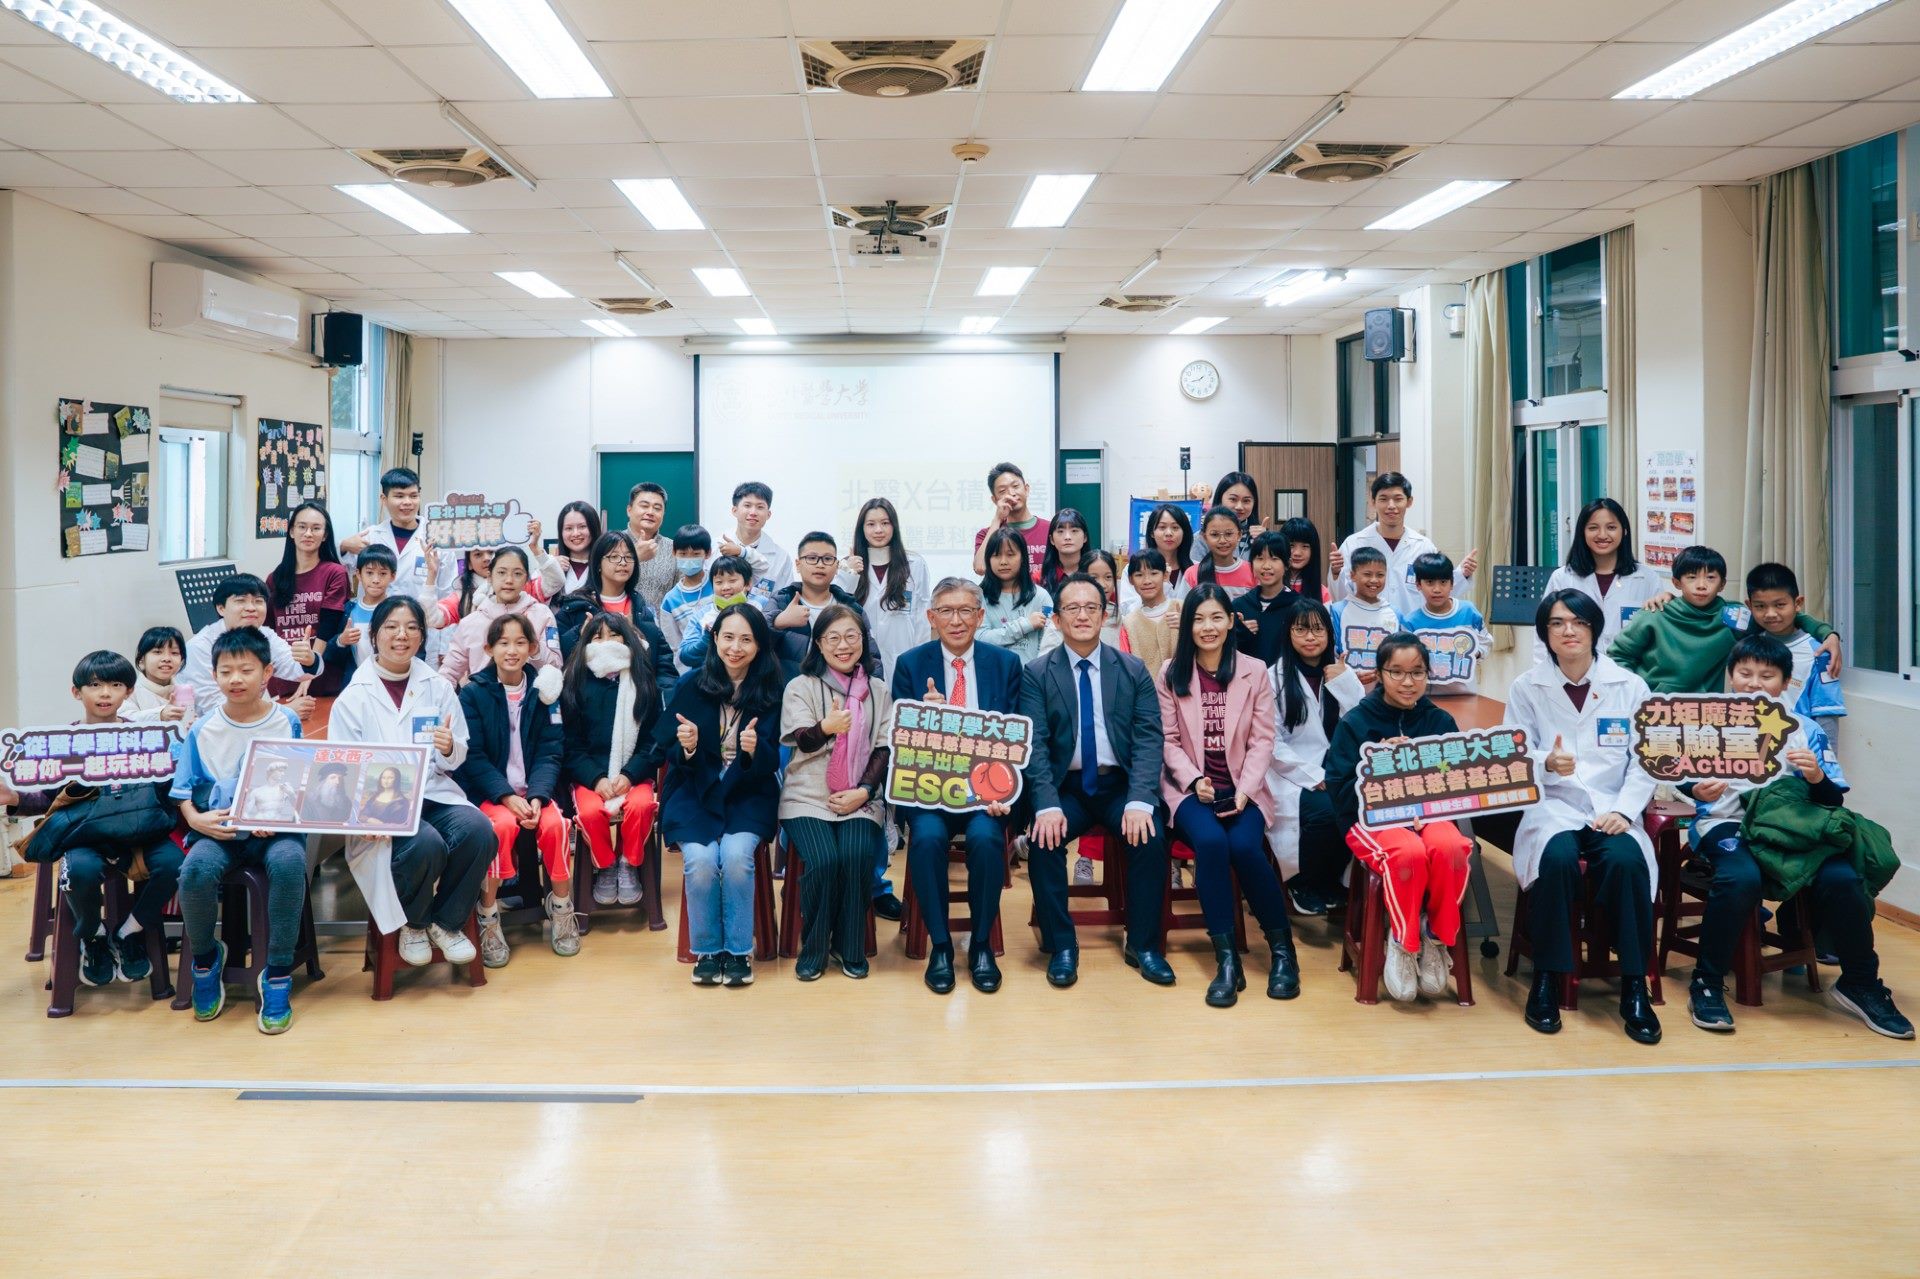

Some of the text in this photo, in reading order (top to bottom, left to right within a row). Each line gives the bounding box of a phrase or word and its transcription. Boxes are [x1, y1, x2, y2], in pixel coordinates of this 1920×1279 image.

[428, 503, 506, 520] 臺北醫學大學
[427, 518, 504, 546] 好棒棒
[276, 613, 319, 627] FUTURE
[285, 603, 307, 615] THE
[897, 706, 1026, 743] 臺北醫學大學
[1645, 701, 1756, 726] 力矩魔法
[24, 729, 165, 759] 從醫學到科學
[894, 728, 1025, 762] 台積電慈善基金會
[1370, 733, 1517, 776] 臺北醫學大學
[1644, 724, 1760, 760] 實驗室
[14, 751, 173, 782] 帶你一起玩科學
[896, 746, 972, 774] 聯手出擊
[1676, 755, 1766, 776] Action
[892, 768, 968, 806] ESG
[1363, 760, 1529, 804] 台積電慈善基金會
